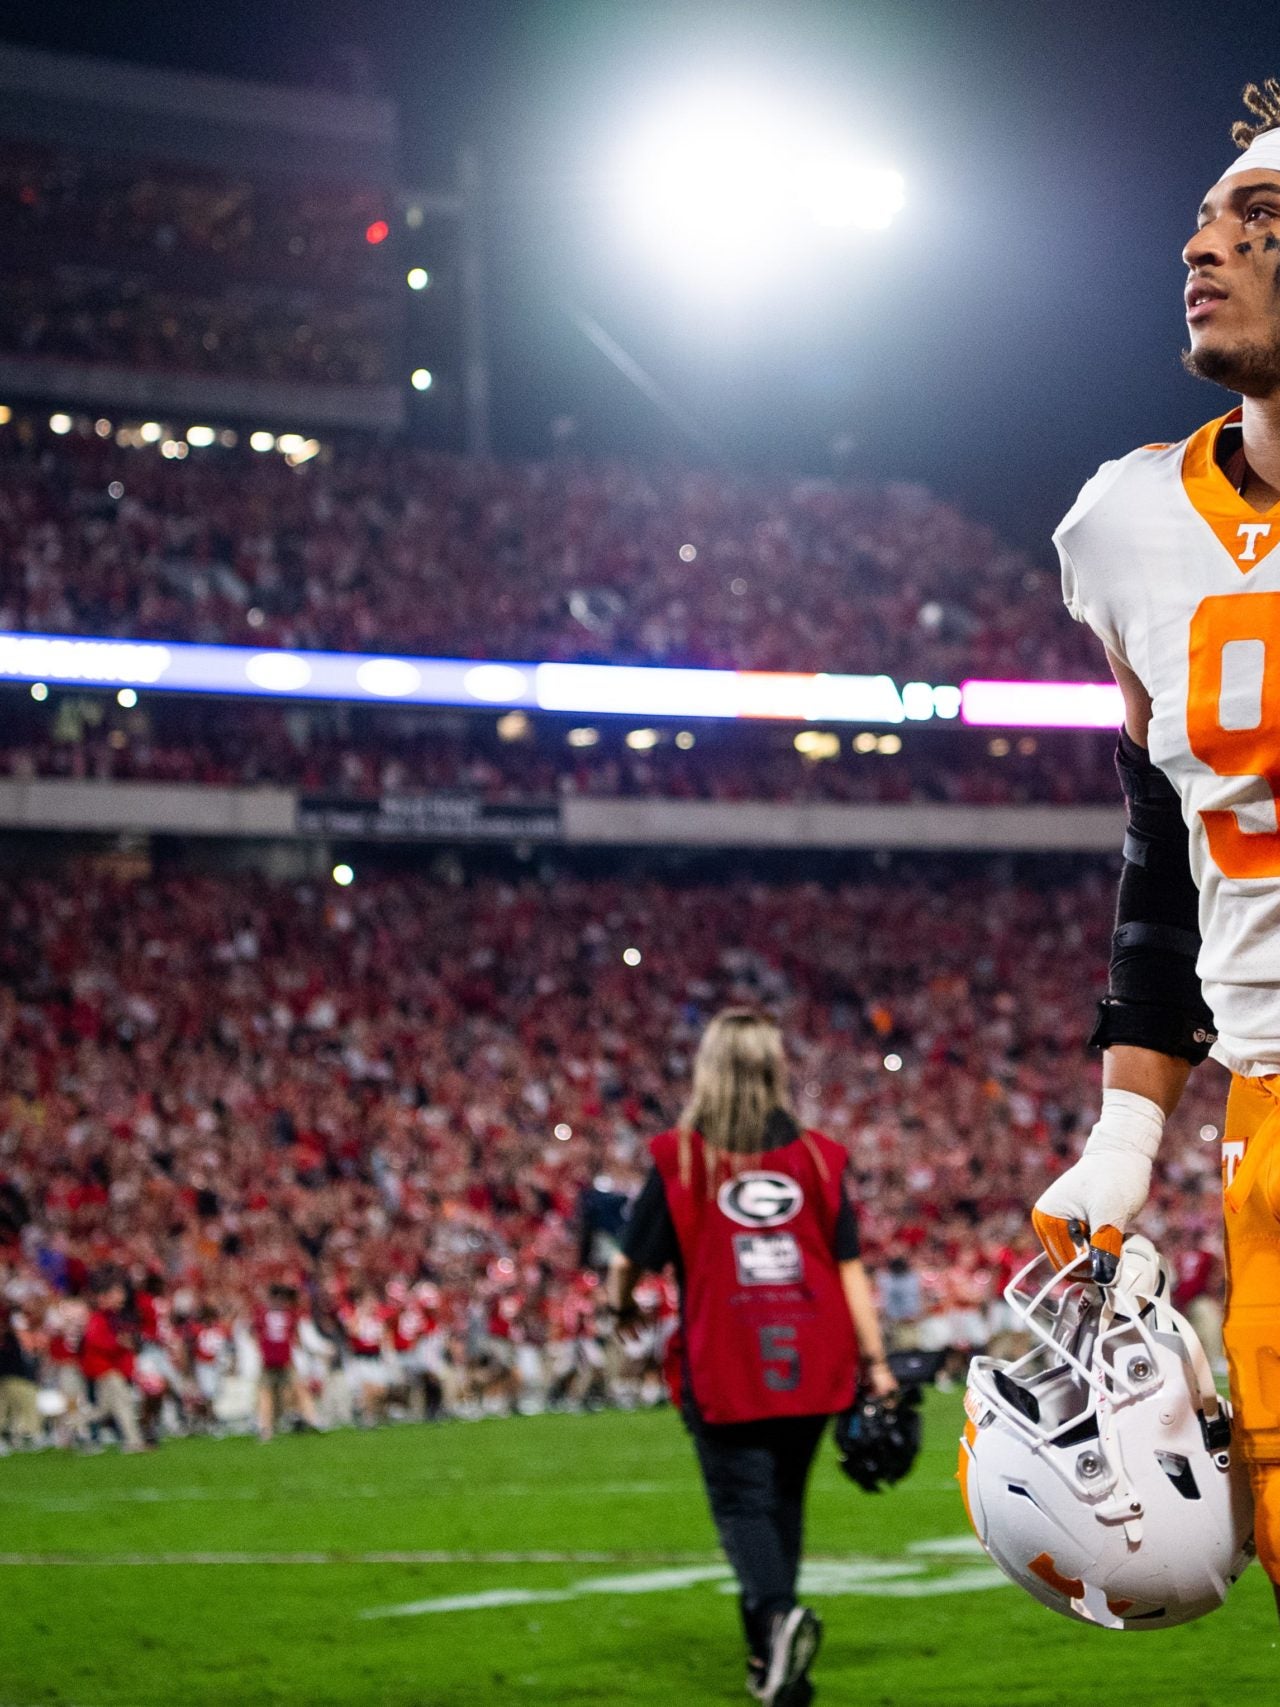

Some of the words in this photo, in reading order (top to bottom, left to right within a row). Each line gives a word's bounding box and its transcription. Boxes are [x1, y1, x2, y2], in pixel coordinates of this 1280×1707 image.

[1236, 523, 1271, 560] T
[723, 1176, 797, 1224] G
[760, 1326, 801, 1391] 5
